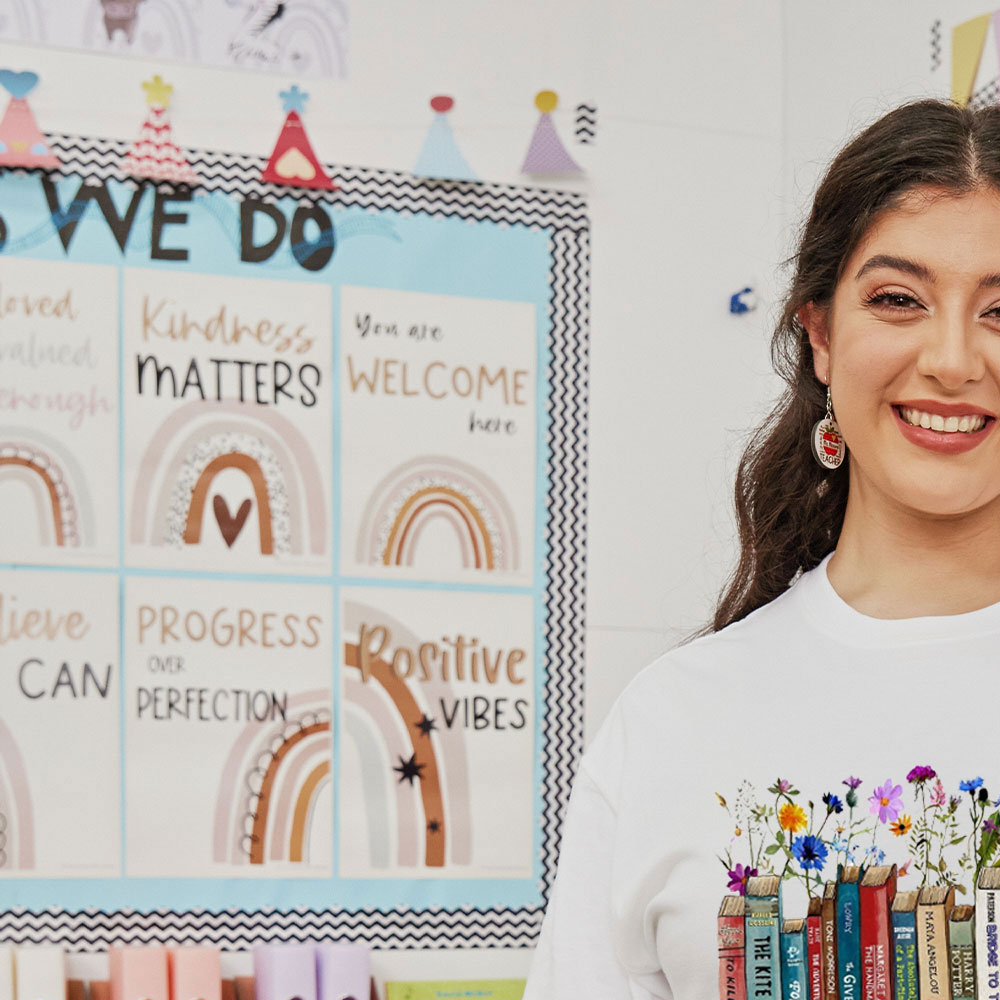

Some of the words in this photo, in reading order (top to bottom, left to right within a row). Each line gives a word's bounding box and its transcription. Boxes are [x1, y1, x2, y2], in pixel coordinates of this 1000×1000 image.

[41, 178, 193, 262] WE
[240, 196, 336, 272] DO
[142, 297, 316, 354] Kindness
[356, 313, 399, 339] You
[408, 323, 443, 341] are
[136, 354, 322, 408] MATTERS
[347, 355, 530, 405] WELCOME
[468, 412, 517, 434] here
[137, 606, 322, 648] PROGRESS
[148, 655, 185, 674] OVER
[359, 623, 528, 685] Positive
[18, 658, 113, 700] CAN
[137, 687, 288, 723] PERFECTION
[439, 696, 529, 731] VIBES
[753, 935, 771, 960] THE
[925, 911, 936, 943] MAYA
[986, 924, 999, 967] BRIDGE
[725, 958, 735, 972] TO
[812, 953, 820, 966] THE
[826, 946, 836, 994] MORRISON
[864, 945, 873, 964] THE
[876, 944, 886, 997] MARGARET
[927, 943, 940, 995] ANGELOU
[951, 950, 963, 996] POTTER
[963, 951, 975, 993] HARRY
[754, 966, 772, 997] KITE
[988, 970, 1000, 989] TO
